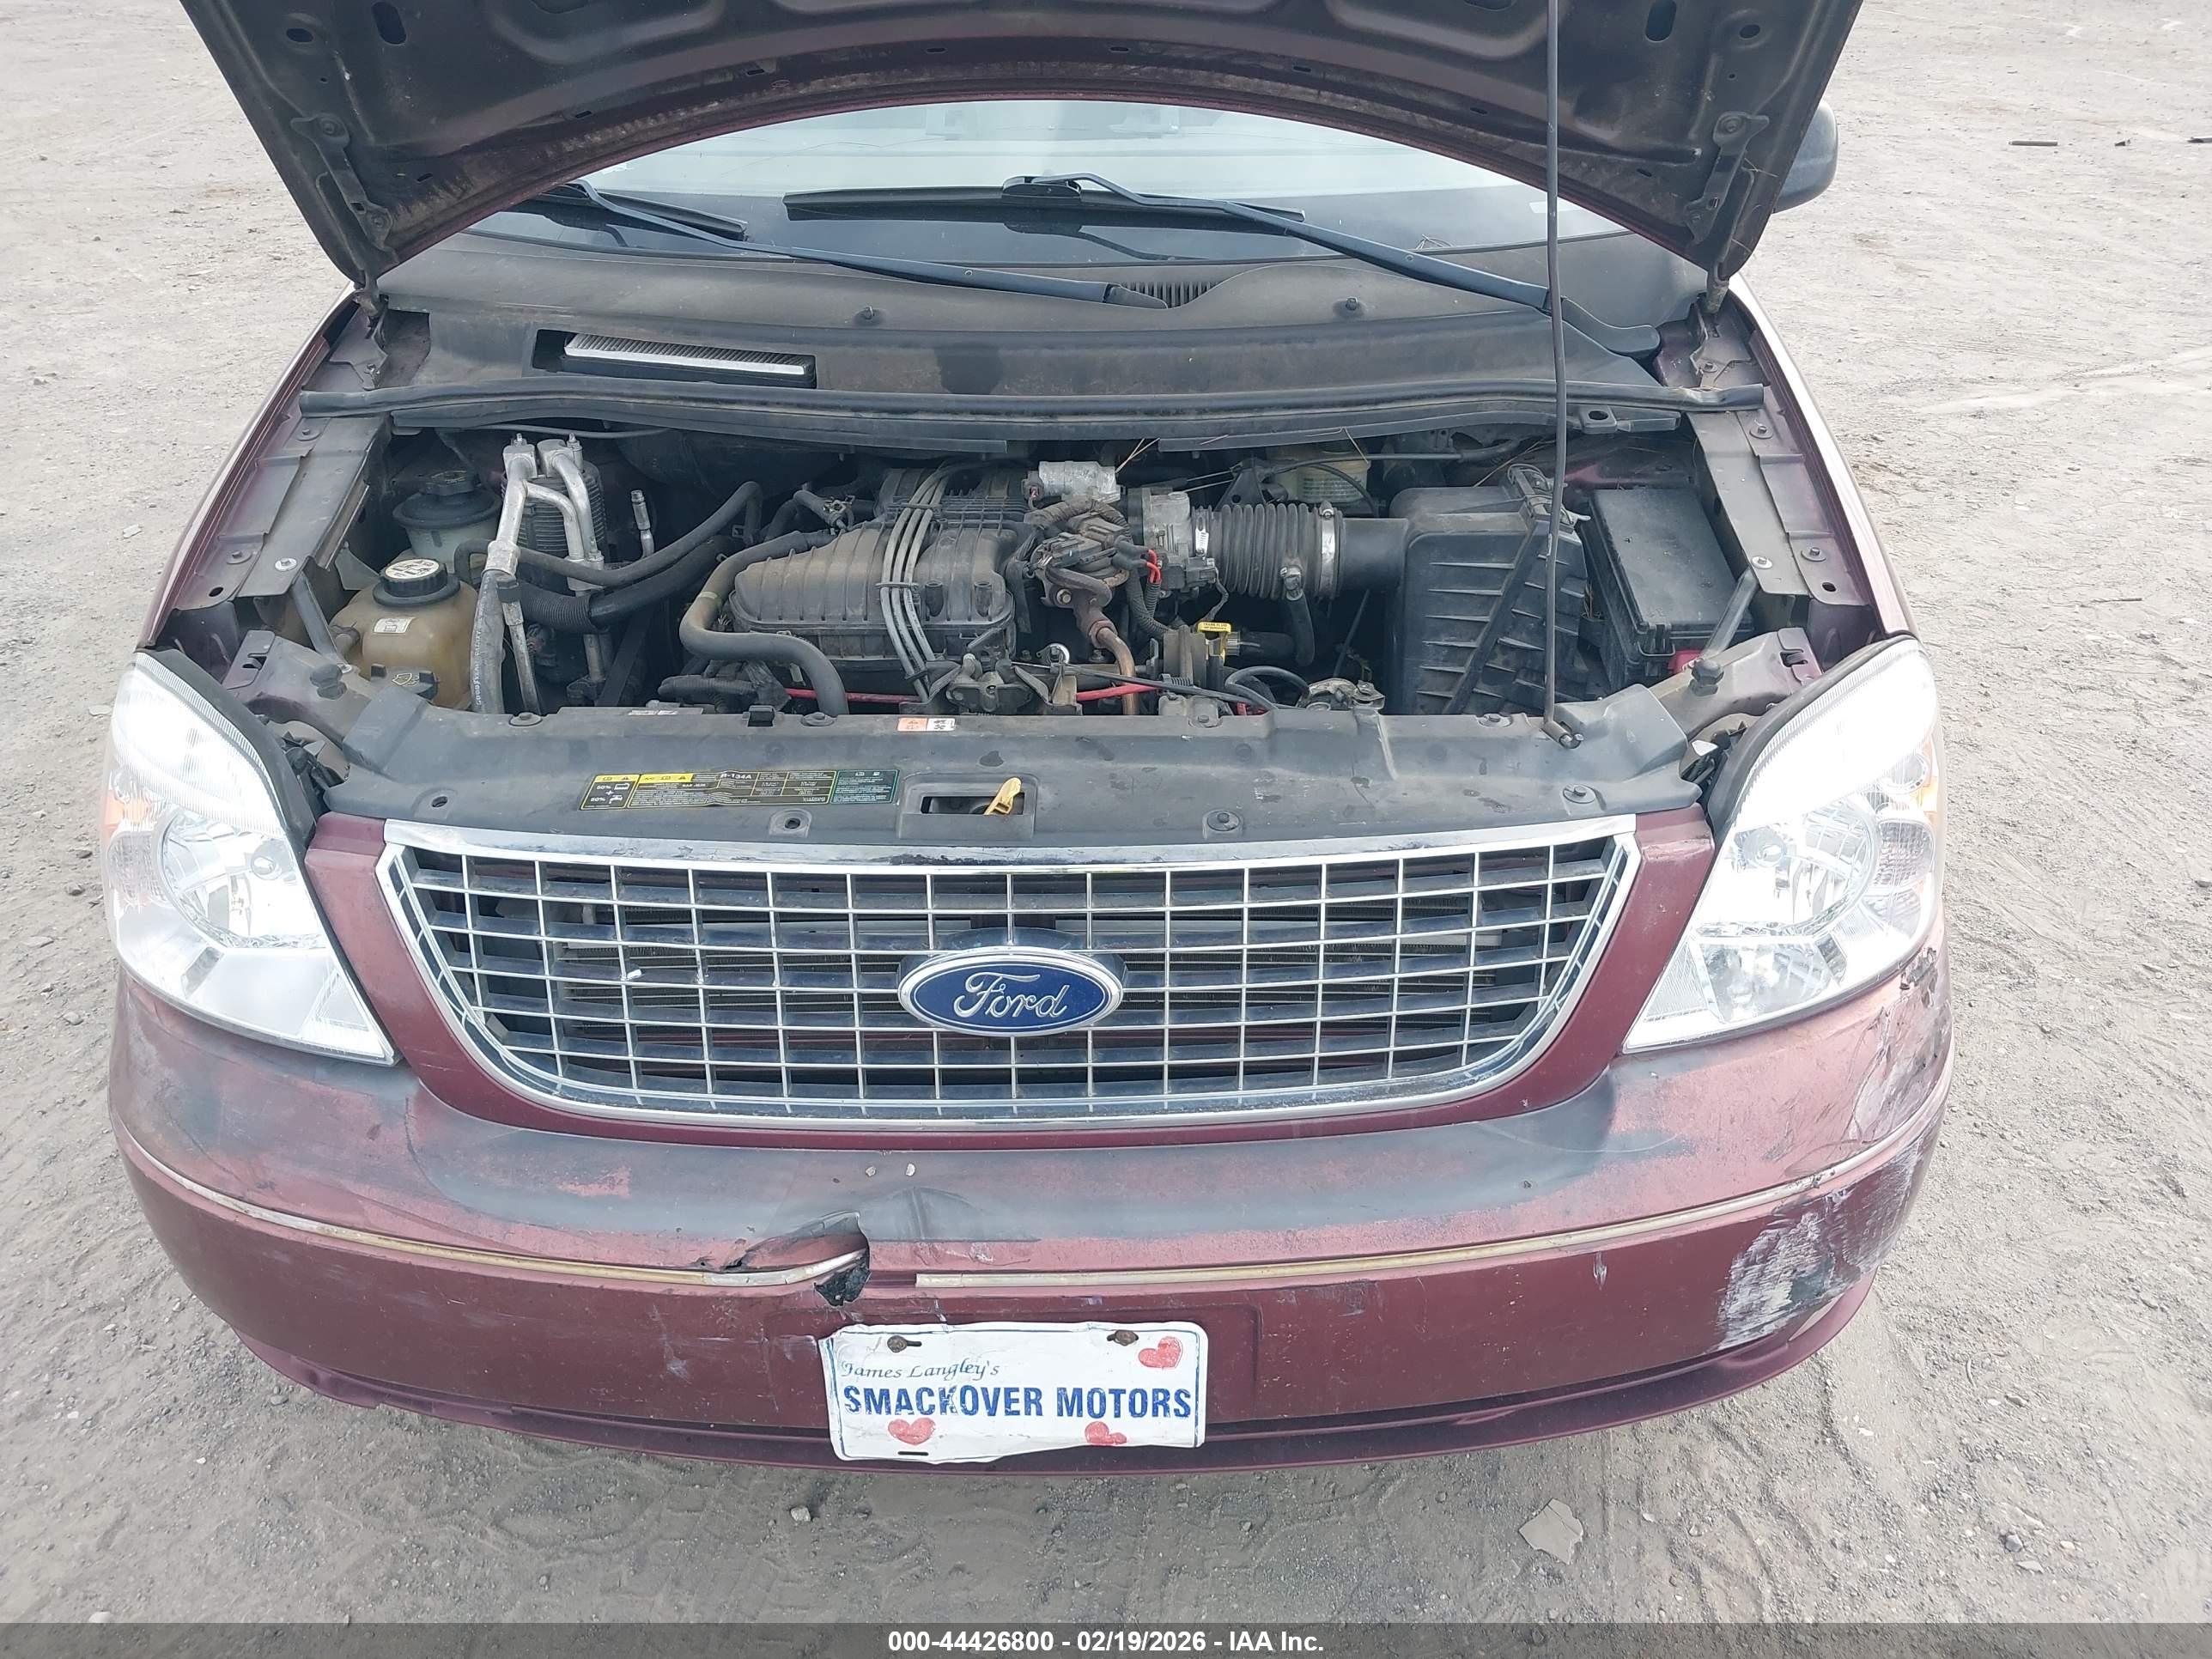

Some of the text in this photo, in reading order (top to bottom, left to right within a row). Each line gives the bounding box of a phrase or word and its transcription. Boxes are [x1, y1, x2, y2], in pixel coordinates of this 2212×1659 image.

[953, 971, 1071, 1018] Ford
[841, 1358, 1000, 1381] James Langley's
[843, 1384, 1192, 1419] SMACKOVER MOTORS
